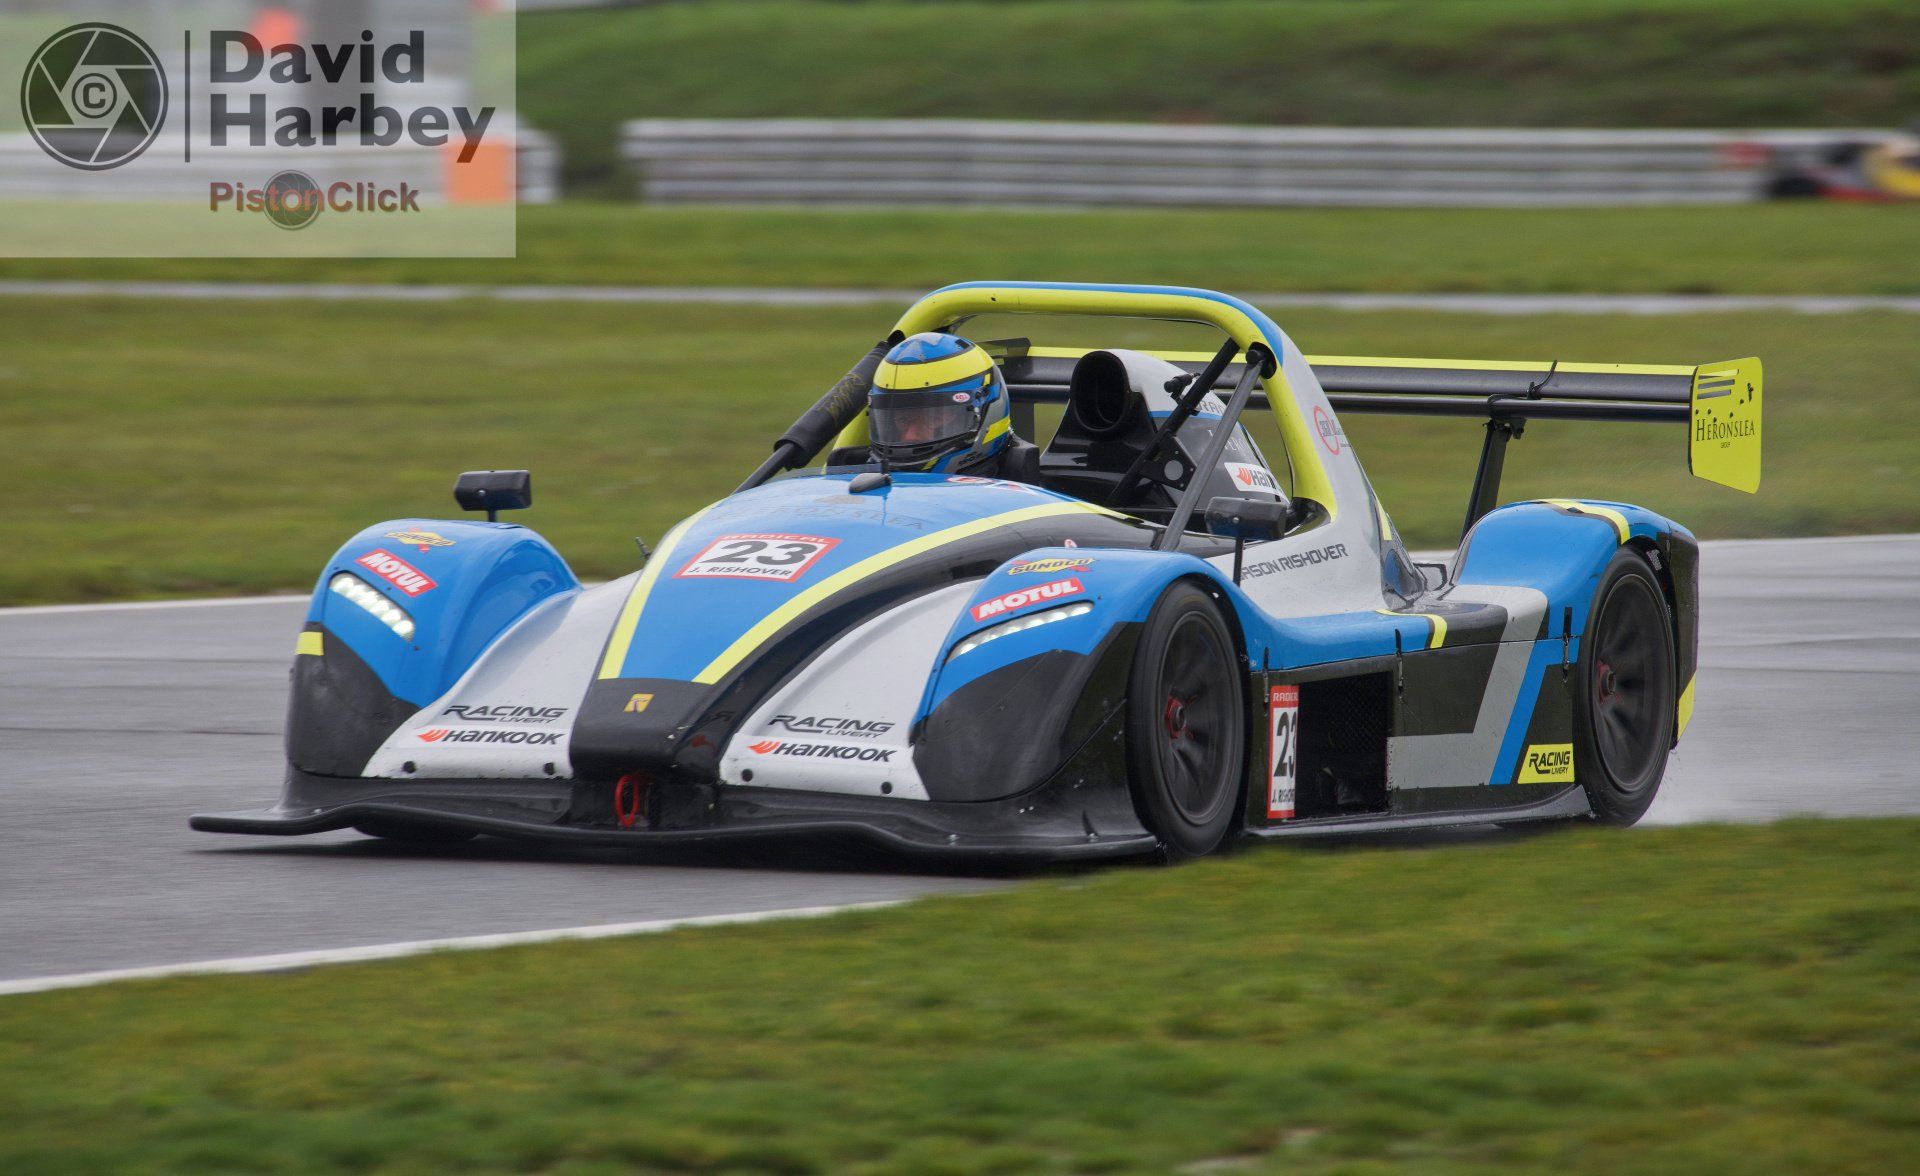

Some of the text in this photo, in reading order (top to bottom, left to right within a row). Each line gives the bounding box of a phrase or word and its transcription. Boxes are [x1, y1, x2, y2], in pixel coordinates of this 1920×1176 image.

[1696, 418, 1755, 441] HERONSLEA
[700, 540, 819, 566] 23
[1241, 543, 1349, 581] ASON RISHOVER
[359, 551, 431, 594] MOTUL
[710, 566, 793, 577] RISHOVER
[1011, 558, 1091, 573] SUNOCO
[978, 580, 1078, 619] MOTUL
[443, 705, 569, 721] RACING
[768, 715, 896, 734] RACING
[825, 729, 883, 739] LIVERY
[1529, 751, 1570, 774] RACING
